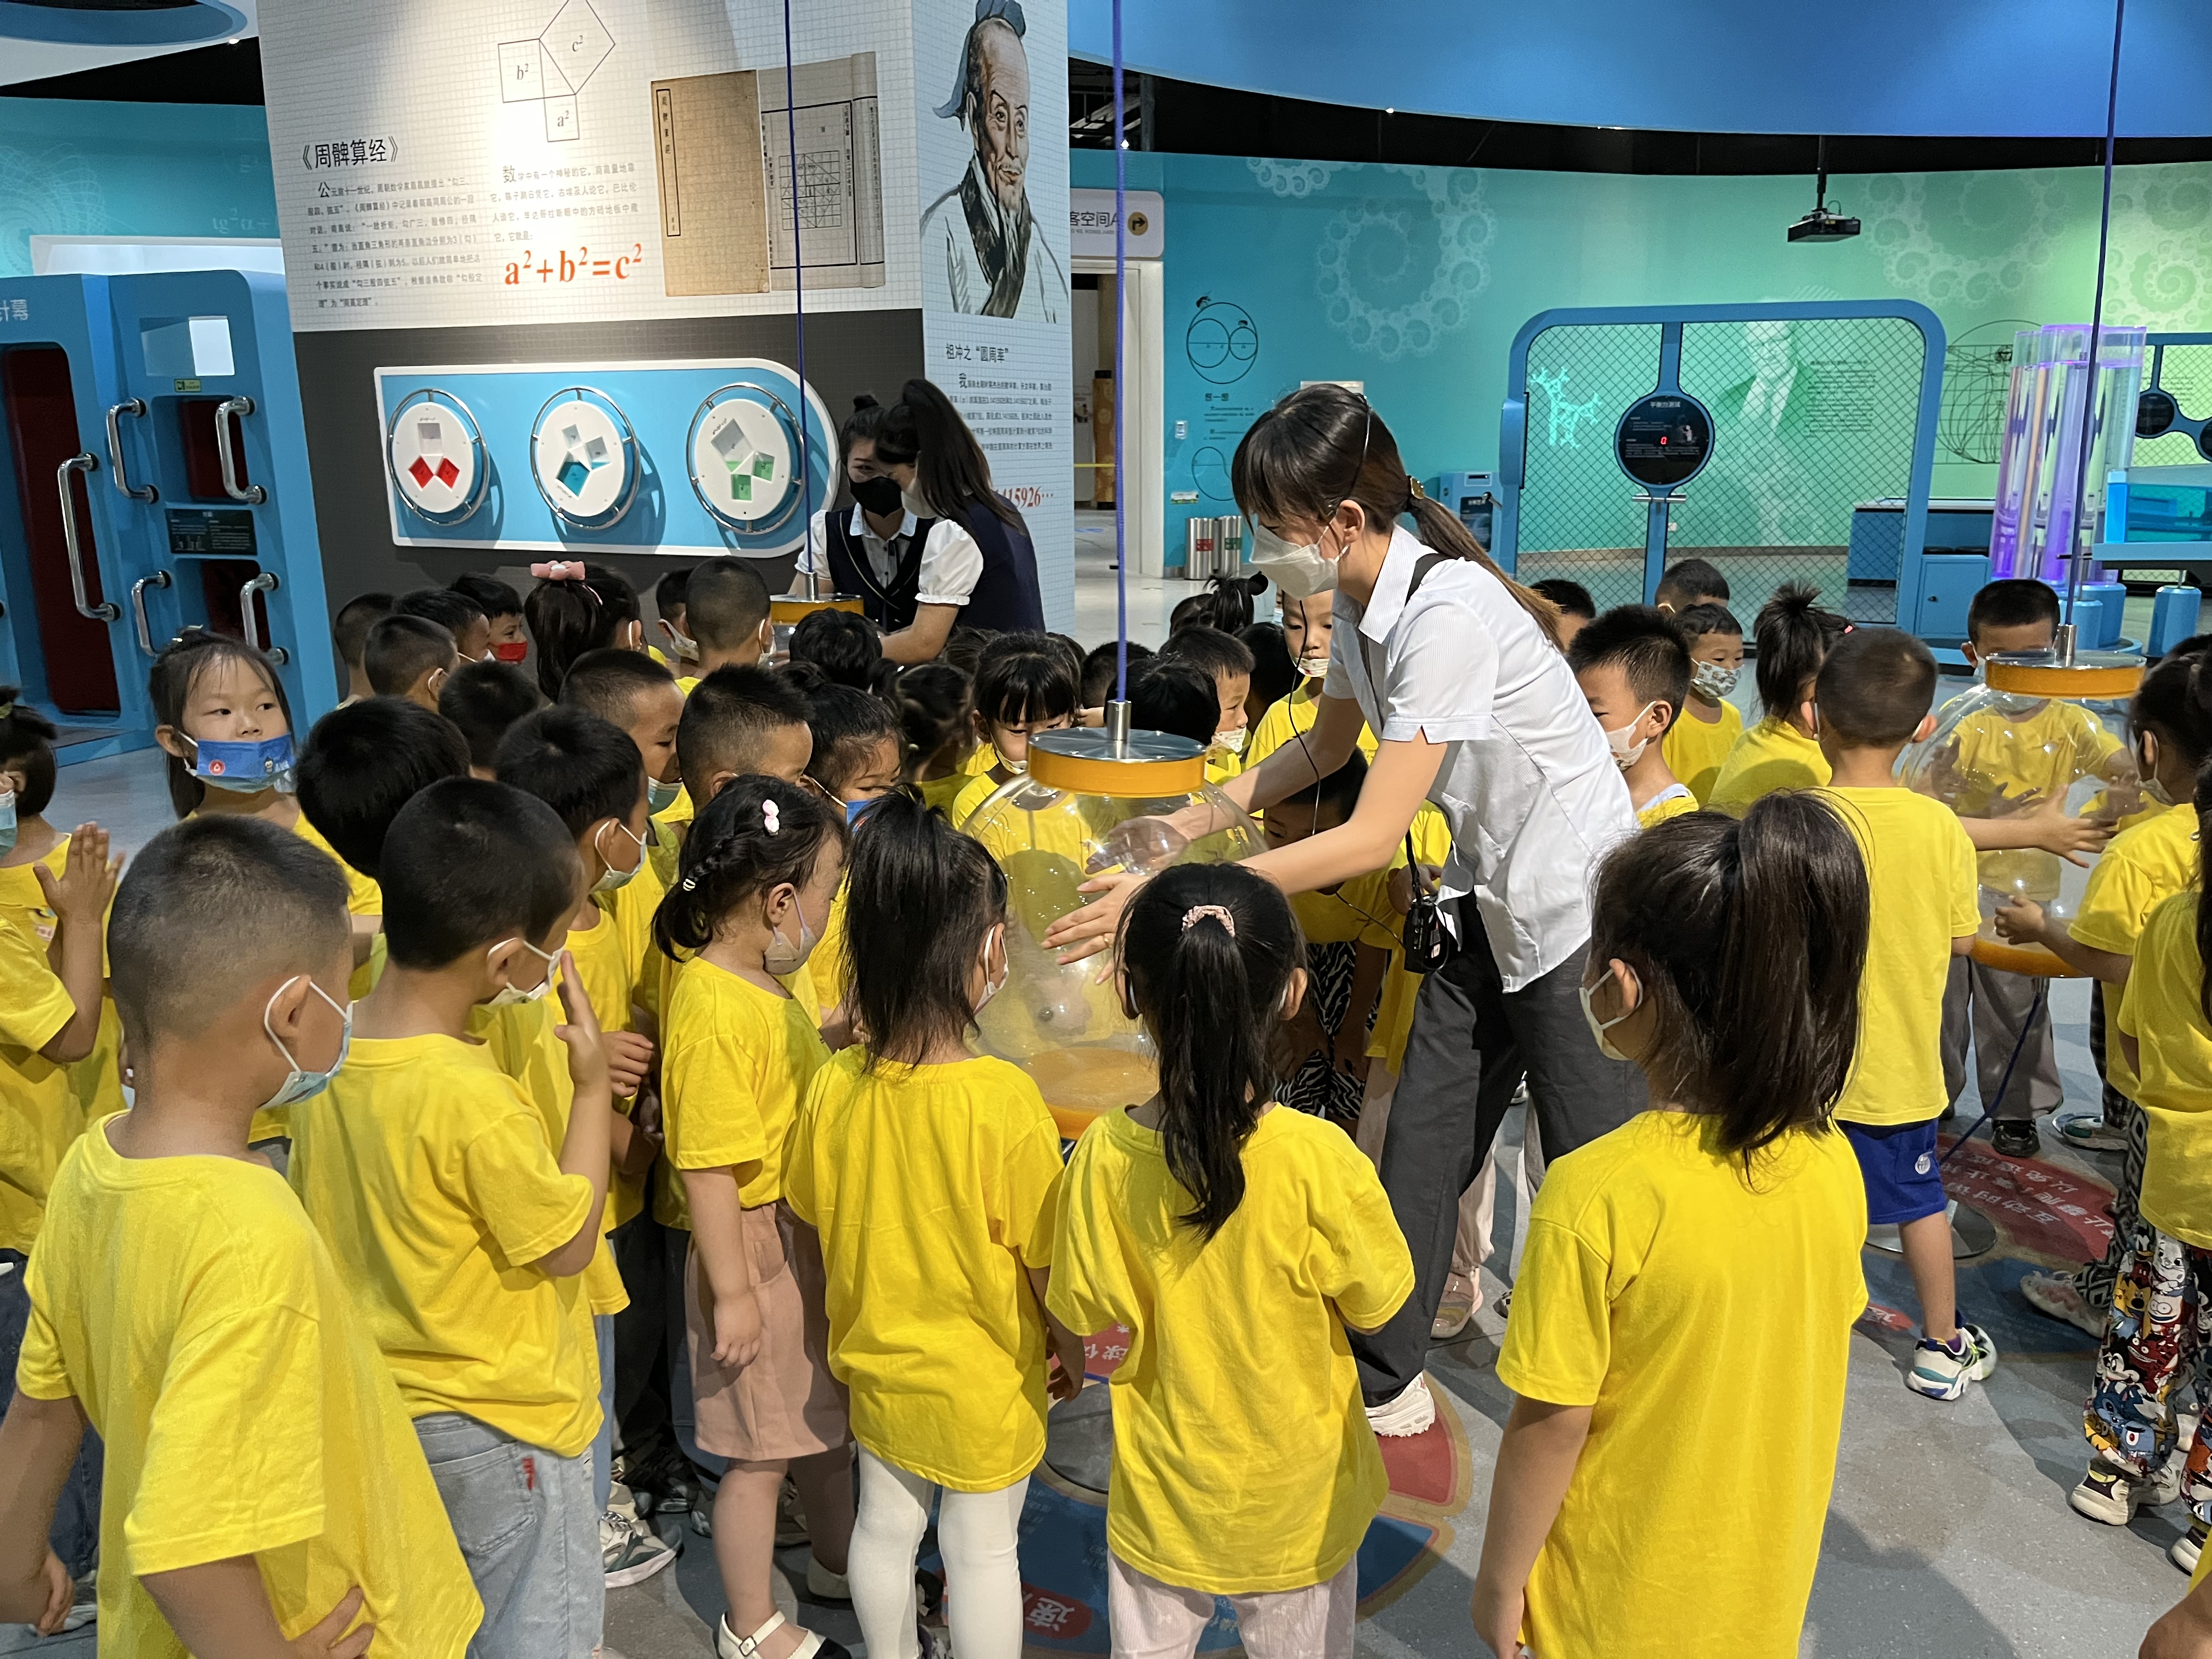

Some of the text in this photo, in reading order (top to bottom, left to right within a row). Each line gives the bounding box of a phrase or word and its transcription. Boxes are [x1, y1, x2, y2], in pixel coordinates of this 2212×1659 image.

[302, 136, 399, 171] 《周髀算经》
[1022, 1592, 1075, 1633] 速
